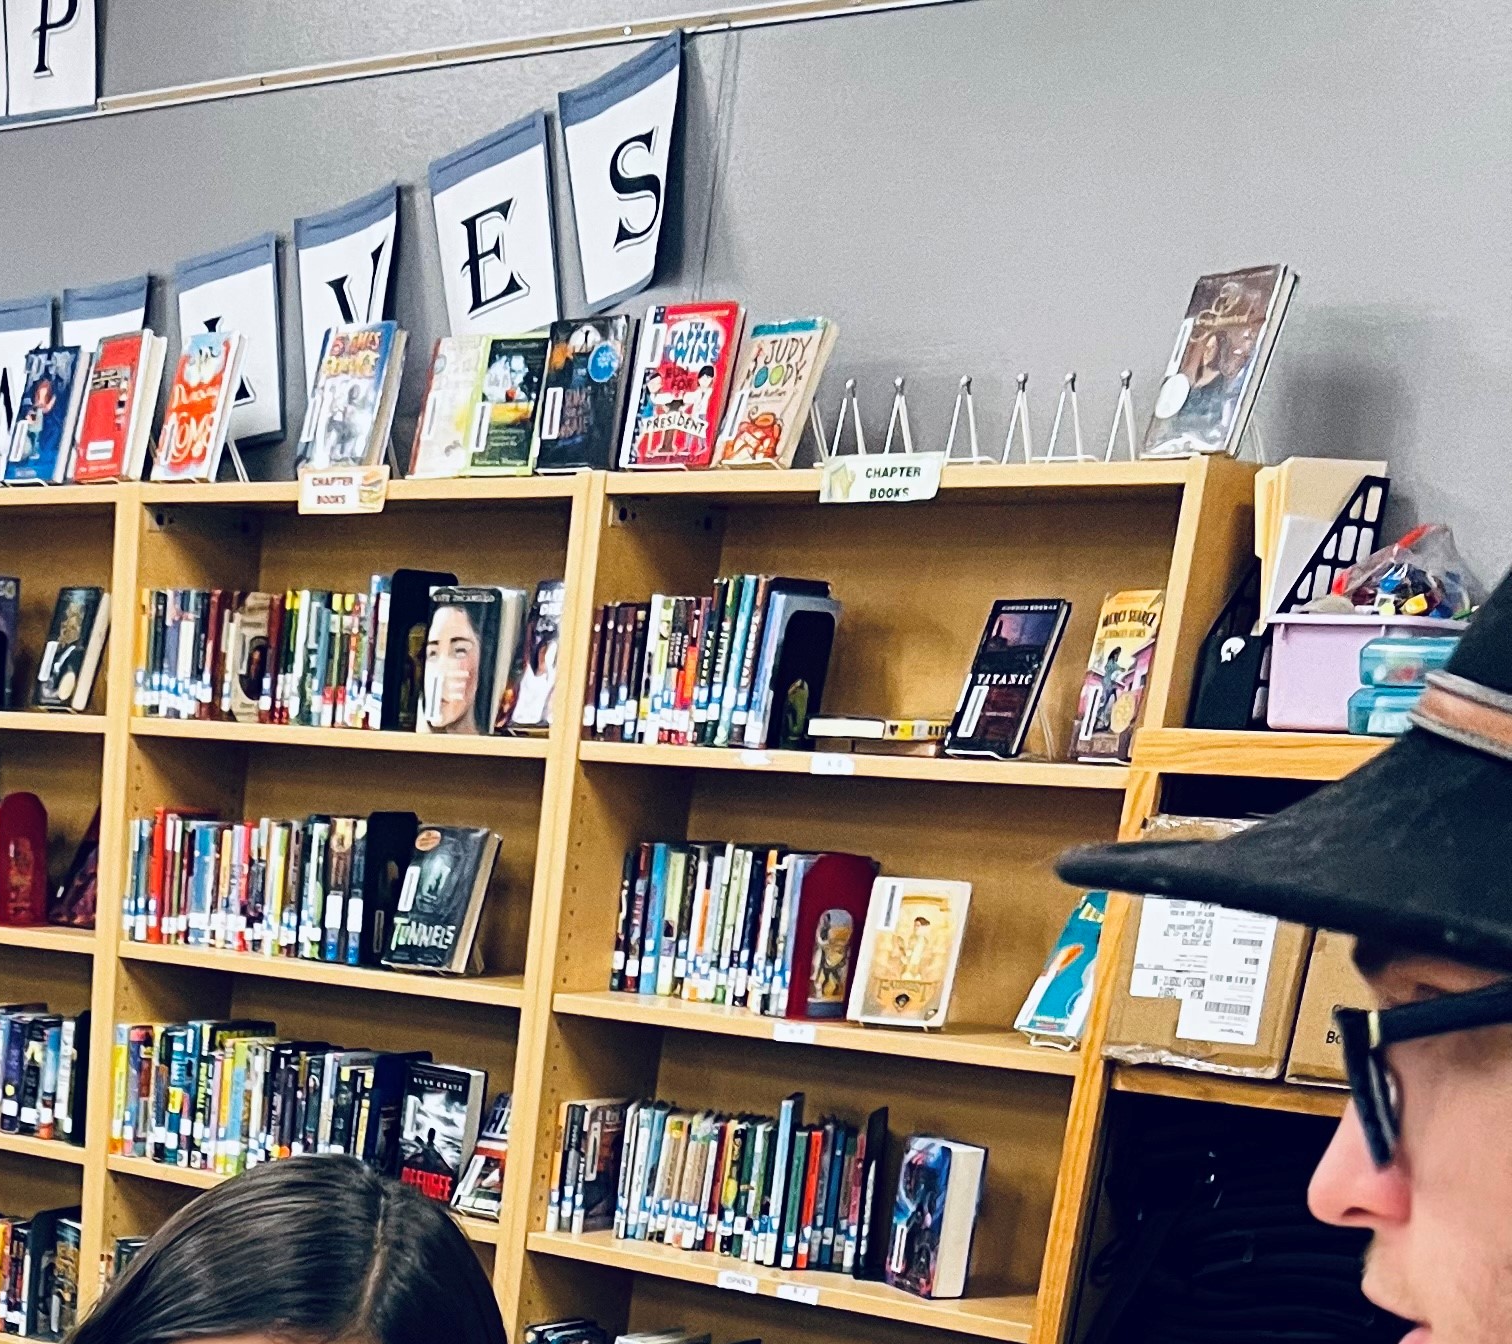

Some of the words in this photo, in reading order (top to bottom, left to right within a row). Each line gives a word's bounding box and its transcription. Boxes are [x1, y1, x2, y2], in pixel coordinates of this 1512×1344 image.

[764, 335, 812, 366] JUDY
[645, 416, 706, 434] PRESIDENT
[865, 466, 921, 478] CHAPTER
[869, 487, 910, 499] BOOKS
[977, 673, 1033, 685] TITANIC
[393, 917, 455, 951] TUNNELS
